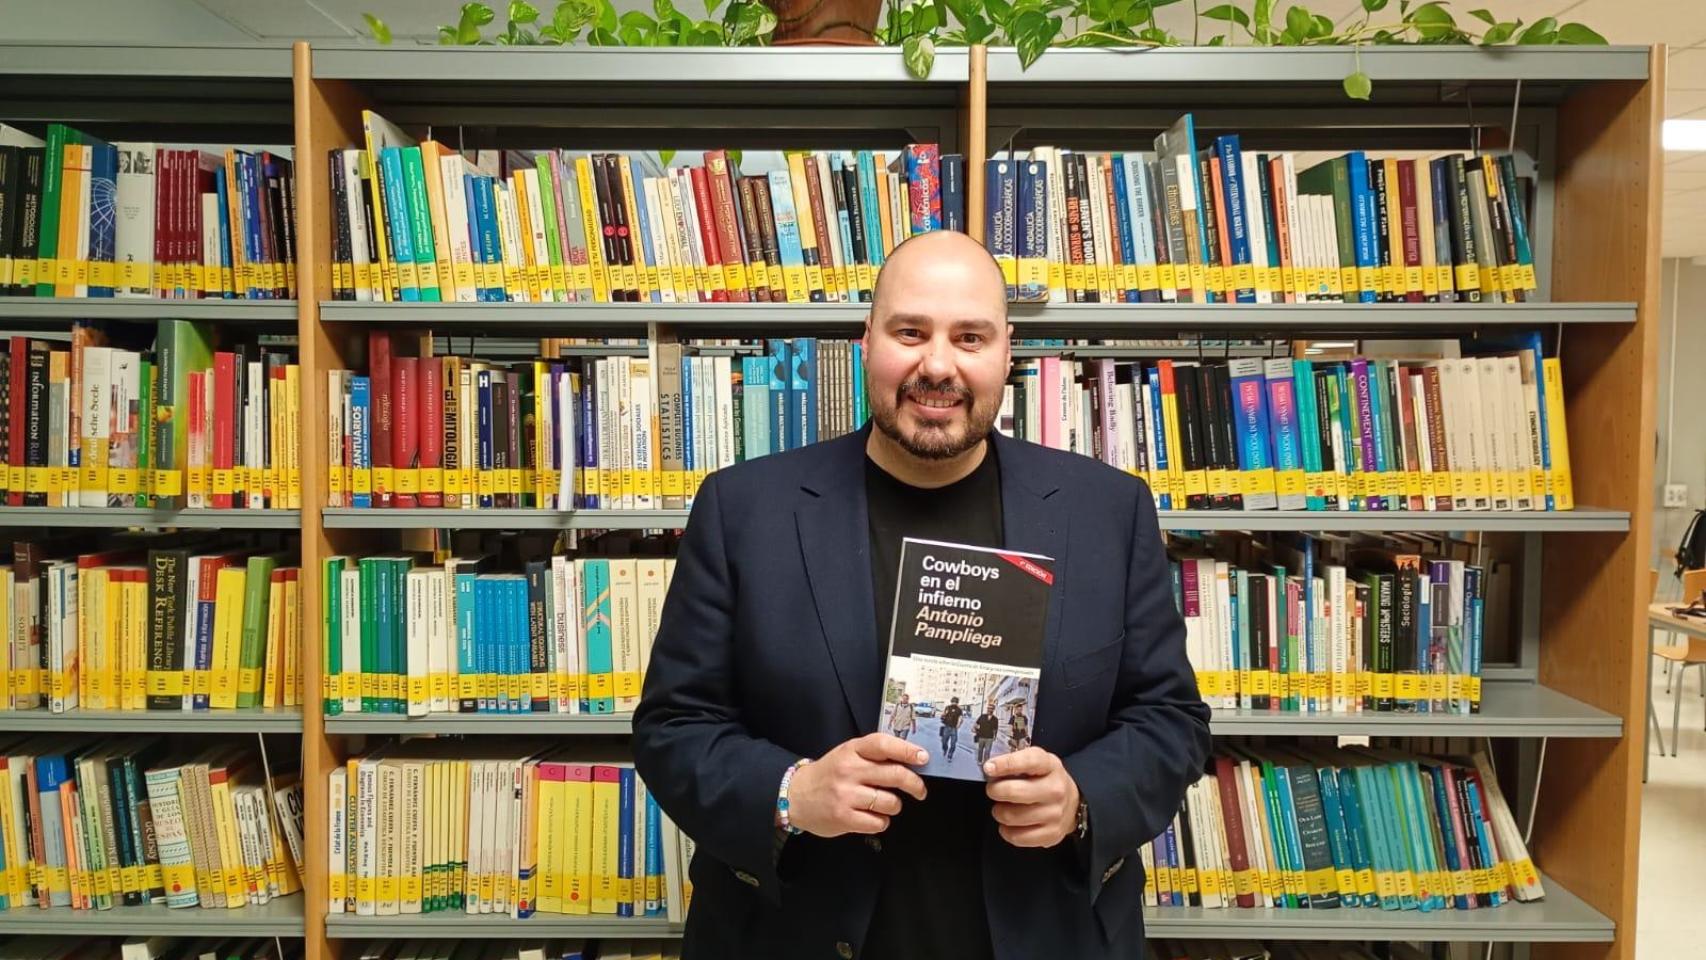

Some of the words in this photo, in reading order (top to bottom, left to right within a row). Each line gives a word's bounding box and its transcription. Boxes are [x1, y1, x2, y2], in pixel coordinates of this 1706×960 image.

[1070, 232, 1083, 265] STRANGER
[1357, 374, 1372, 439] CONFINEMENT
[659, 392, 671, 460] STATISTICS
[166, 557, 176, 572] The
[921, 555, 999, 580] Cowboys
[166, 574, 176, 593] New
[920, 576, 941, 590] en
[945, 577, 960, 591] el
[166, 594, 176, 613] York
[918, 589, 982, 610] infierno
[166, 615, 176, 640] Public
[916, 605, 984, 628] Antonio
[18, 616, 26, 651] LIBROS
[557, 612, 566, 653] business
[914, 622, 1003, 649] Pampliega
[348, 794, 357, 832] CLUSTER
